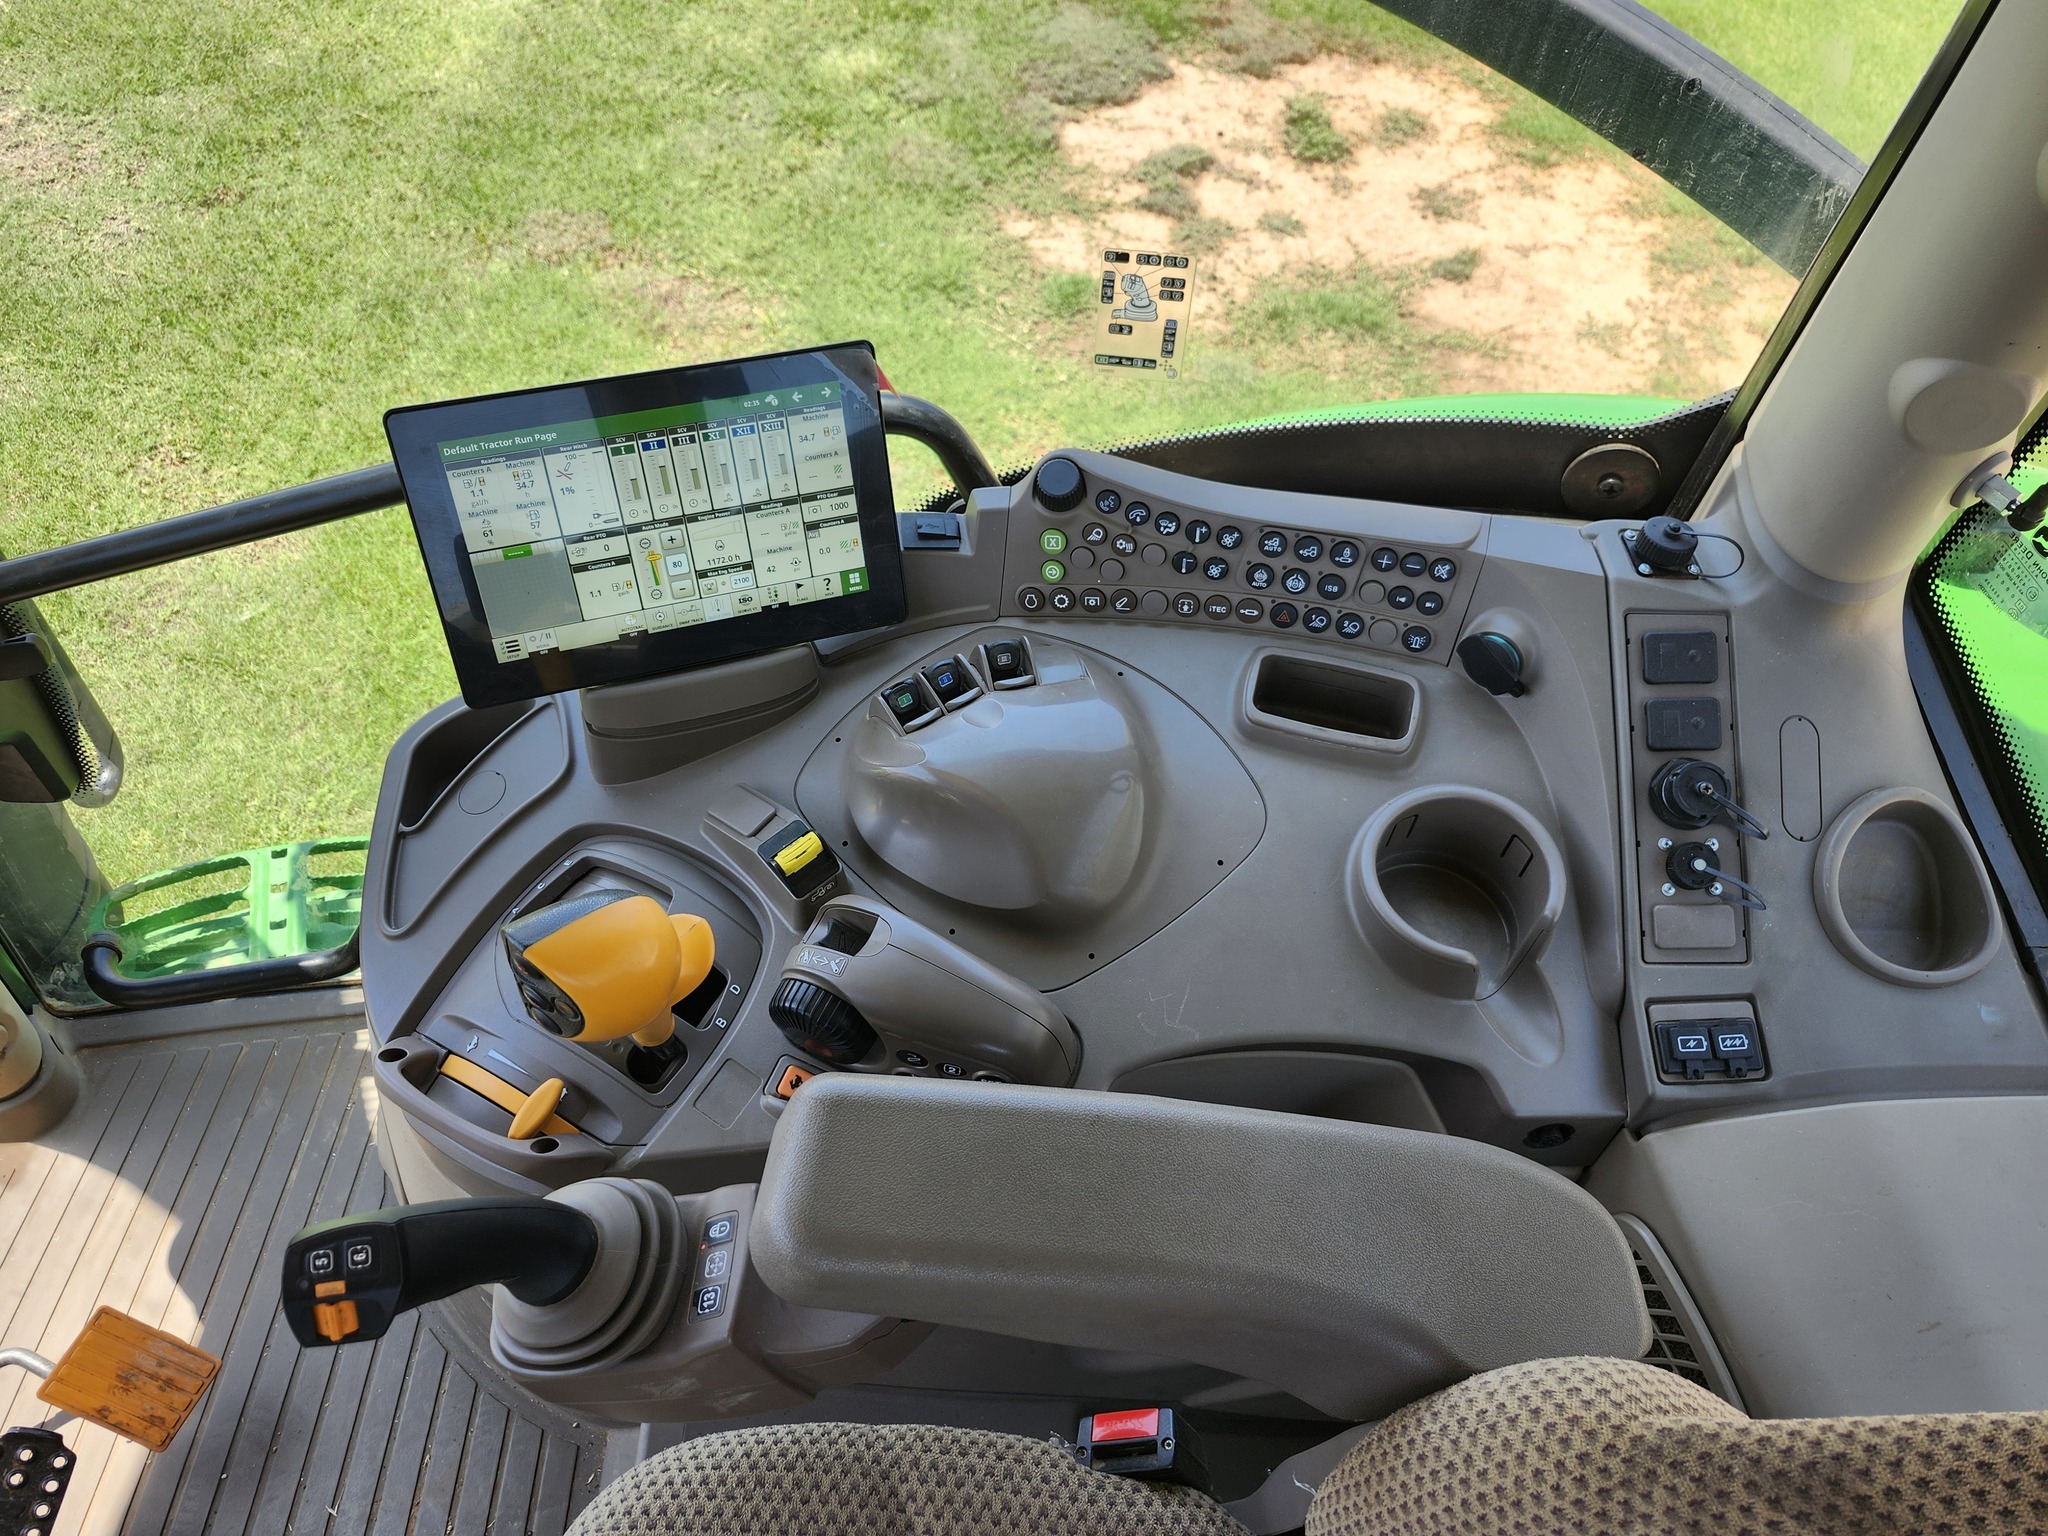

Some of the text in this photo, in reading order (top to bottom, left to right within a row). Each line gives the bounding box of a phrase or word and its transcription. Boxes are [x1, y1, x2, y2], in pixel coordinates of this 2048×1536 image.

[743, 400, 760, 408] 02:35
[803, 405, 826, 413] Readings
[802, 413, 829, 422] Machine
[763, 421, 781, 431] XIII
[708, 431, 720, 440] XI
[736, 426, 751, 436] XII
[678, 436, 690, 445] III
[798, 433, 815, 443] 34.7
[443, 432, 557, 456] Default Tractor Run Page
[649, 441, 659, 450] II
[620, 446, 626, 455] I
[480, 456, 506, 464] Readings
[564, 453, 577, 461] 100
[805, 451, 833, 462] Counters
[505, 460, 536, 470] Machine
[452, 467, 485, 478] Counters
[515, 480, 534, 491] 34.7
[470, 489, 484, 498] 1.1
[560, 486, 576, 496] 1%
[471, 499, 489, 508] gal/h
[516, 500, 546, 510] Machine
[760, 501, 783, 509] Readings
[829, 501, 849, 511] 1000
[468, 508, 498, 518] Machine
[756, 509, 784, 519] Counters
[530, 521, 541, 530] 57
[819, 520, 840, 528] Counters
[482, 529, 494, 537] 61
[808, 530, 819, 538] Avg
[603, 544, 610, 552] 0
[766, 545, 792, 555] Machine
[819, 547, 831, 555] 0.0
[1263, 545, 1282, 553] AUTO
[588, 562, 611, 570] Counters
[672, 560, 683, 568] 80
[707, 556, 734, 567] 1172.0
[766, 565, 776, 573] 42
[734, 576, 750, 585] 2100
[589, 590, 602, 598] 1.1
[738, 596, 753, 604] ISO
[1209, 605, 1227, 614] iTEC
[651, 623, 674, 631] GUIDANCE
[730, 984, 741, 995] D
[715, 1017, 727, 1029] B
[315, 1258, 328, 1266] 5
[702, 1292, 715, 1309] 13
